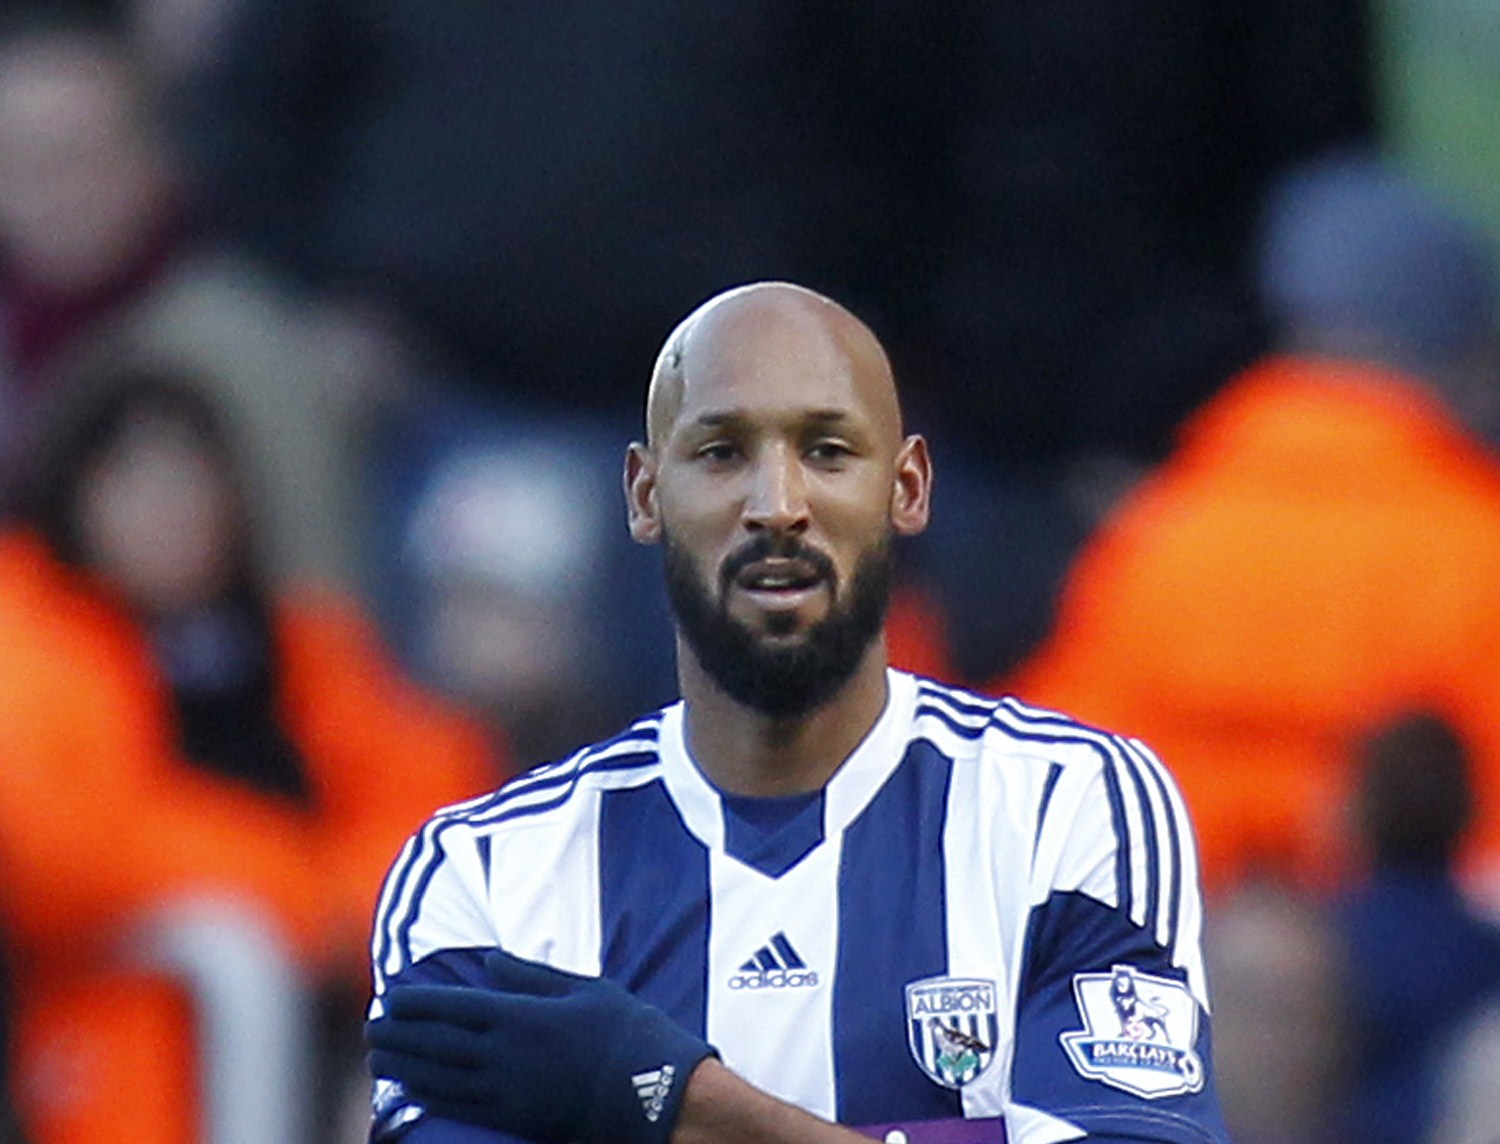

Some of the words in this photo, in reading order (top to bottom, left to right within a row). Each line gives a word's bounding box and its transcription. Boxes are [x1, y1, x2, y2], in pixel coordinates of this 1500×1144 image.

[728, 972, 818, 990] adidas
[915, 992, 990, 1014] ALBION
[1093, 1043, 1177, 1064] BARCLAYS
